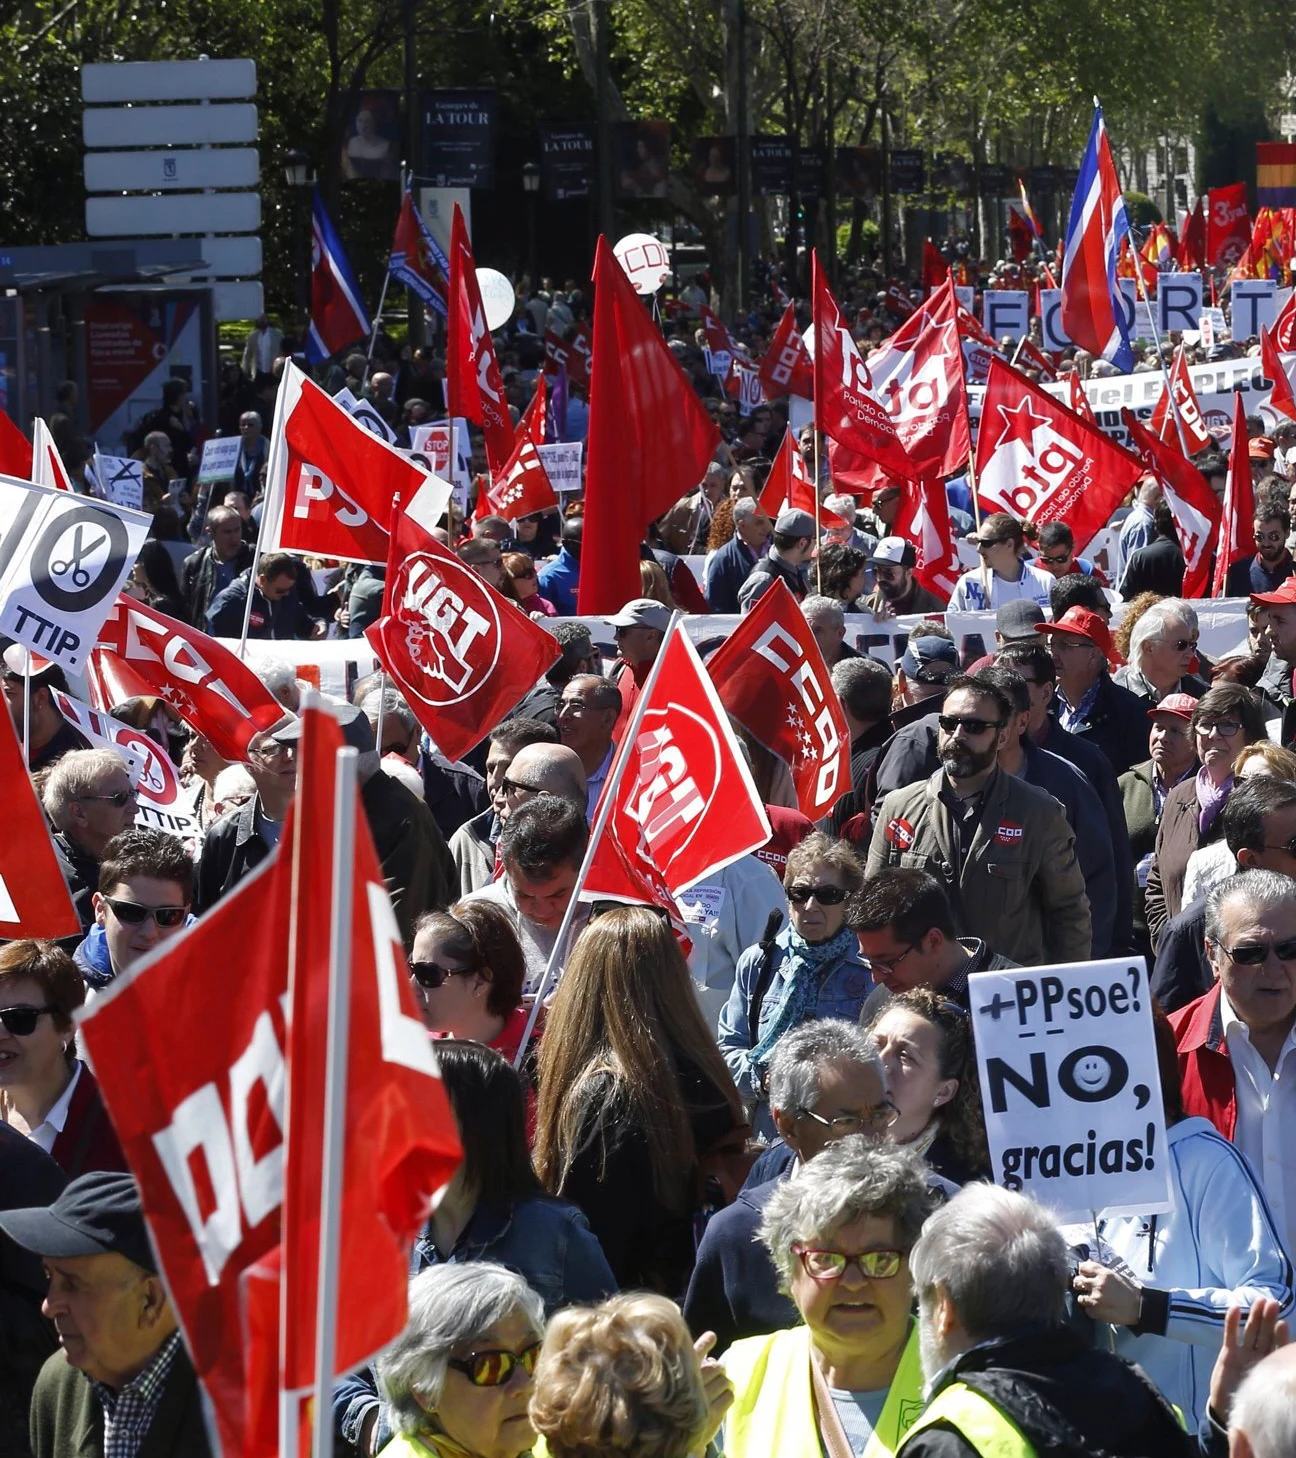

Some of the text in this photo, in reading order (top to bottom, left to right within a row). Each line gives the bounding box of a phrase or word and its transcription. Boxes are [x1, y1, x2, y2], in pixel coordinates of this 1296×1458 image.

[425, 112, 489, 124] LA TOUR
[544, 141, 593, 151] LA TOUR
[1143, 368, 1274, 401] EPLEO
[425, 439, 449, 451] STOP
[402, 560, 492, 661] UGT
[14, 604, 82, 665] TTIP.
[751, 620, 842, 807] CCOO
[888, 820, 914, 845] CCOO
[997, 826, 1023, 837] COO
[757, 849, 788, 864] CCOO
[986, 1044, 1151, 1114] NO,
[1001, 1121, 1156, 1191] gracias!
